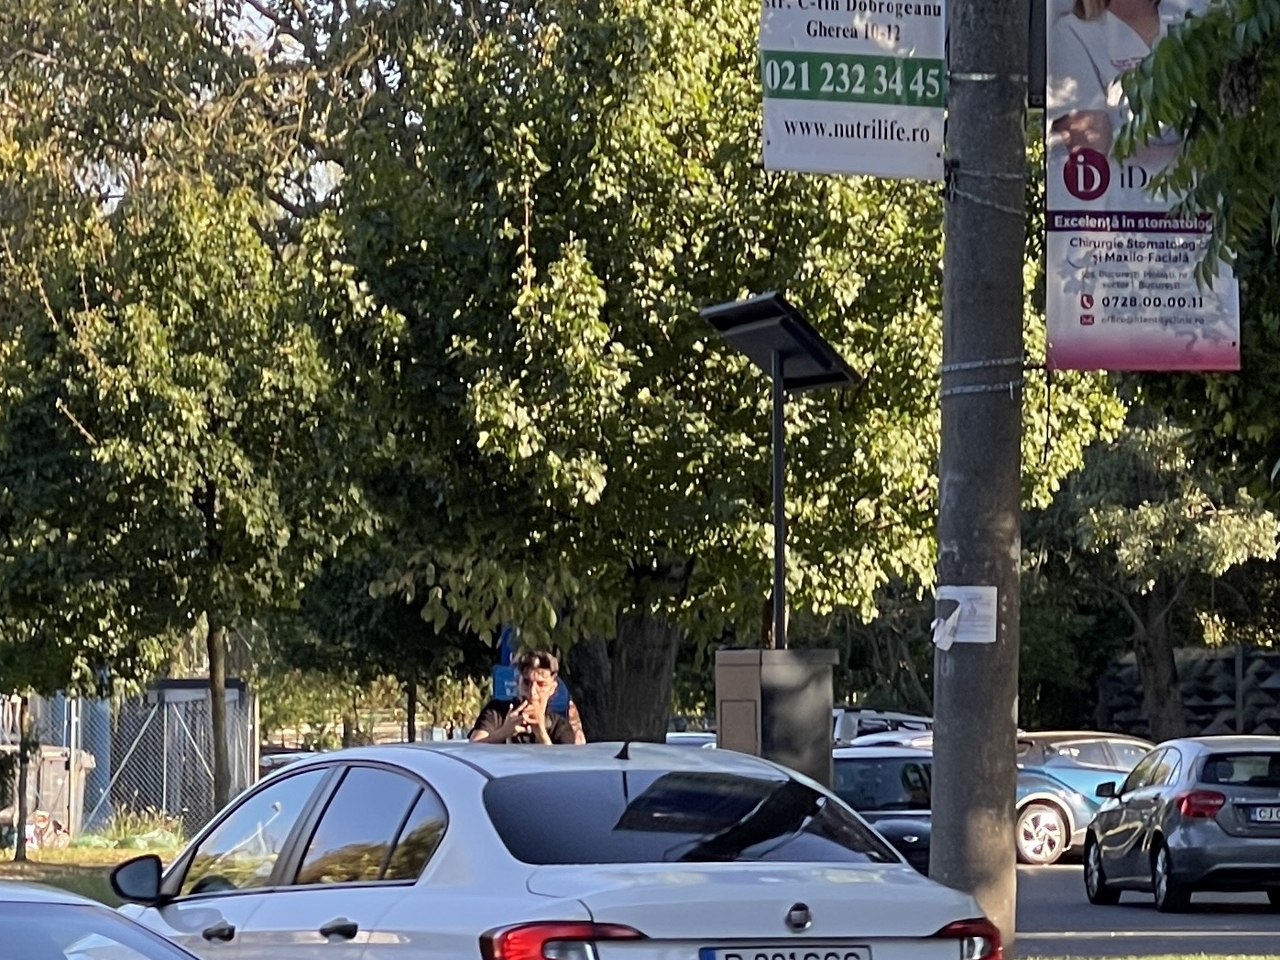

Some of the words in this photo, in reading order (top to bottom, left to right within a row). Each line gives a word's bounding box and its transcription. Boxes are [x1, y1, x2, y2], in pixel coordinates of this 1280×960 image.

[846, 0, 942, 18] Dobrogeanu
[806, 20, 859, 40] Gherea
[864, 22, 901, 41] 10-12
[765, 59, 810, 91] 021
[820, 61, 866, 94] 232
[873, 64, 903, 96] 34
[909, 67, 940, 98] 45
[784, 119, 930, 143] www.nutrilife.ro
[1054, 214, 1120, 231] Excelență
[1069, 236, 1124, 250] Chirurgie
[1101, 296, 1204, 309] 0728.00.00.11
